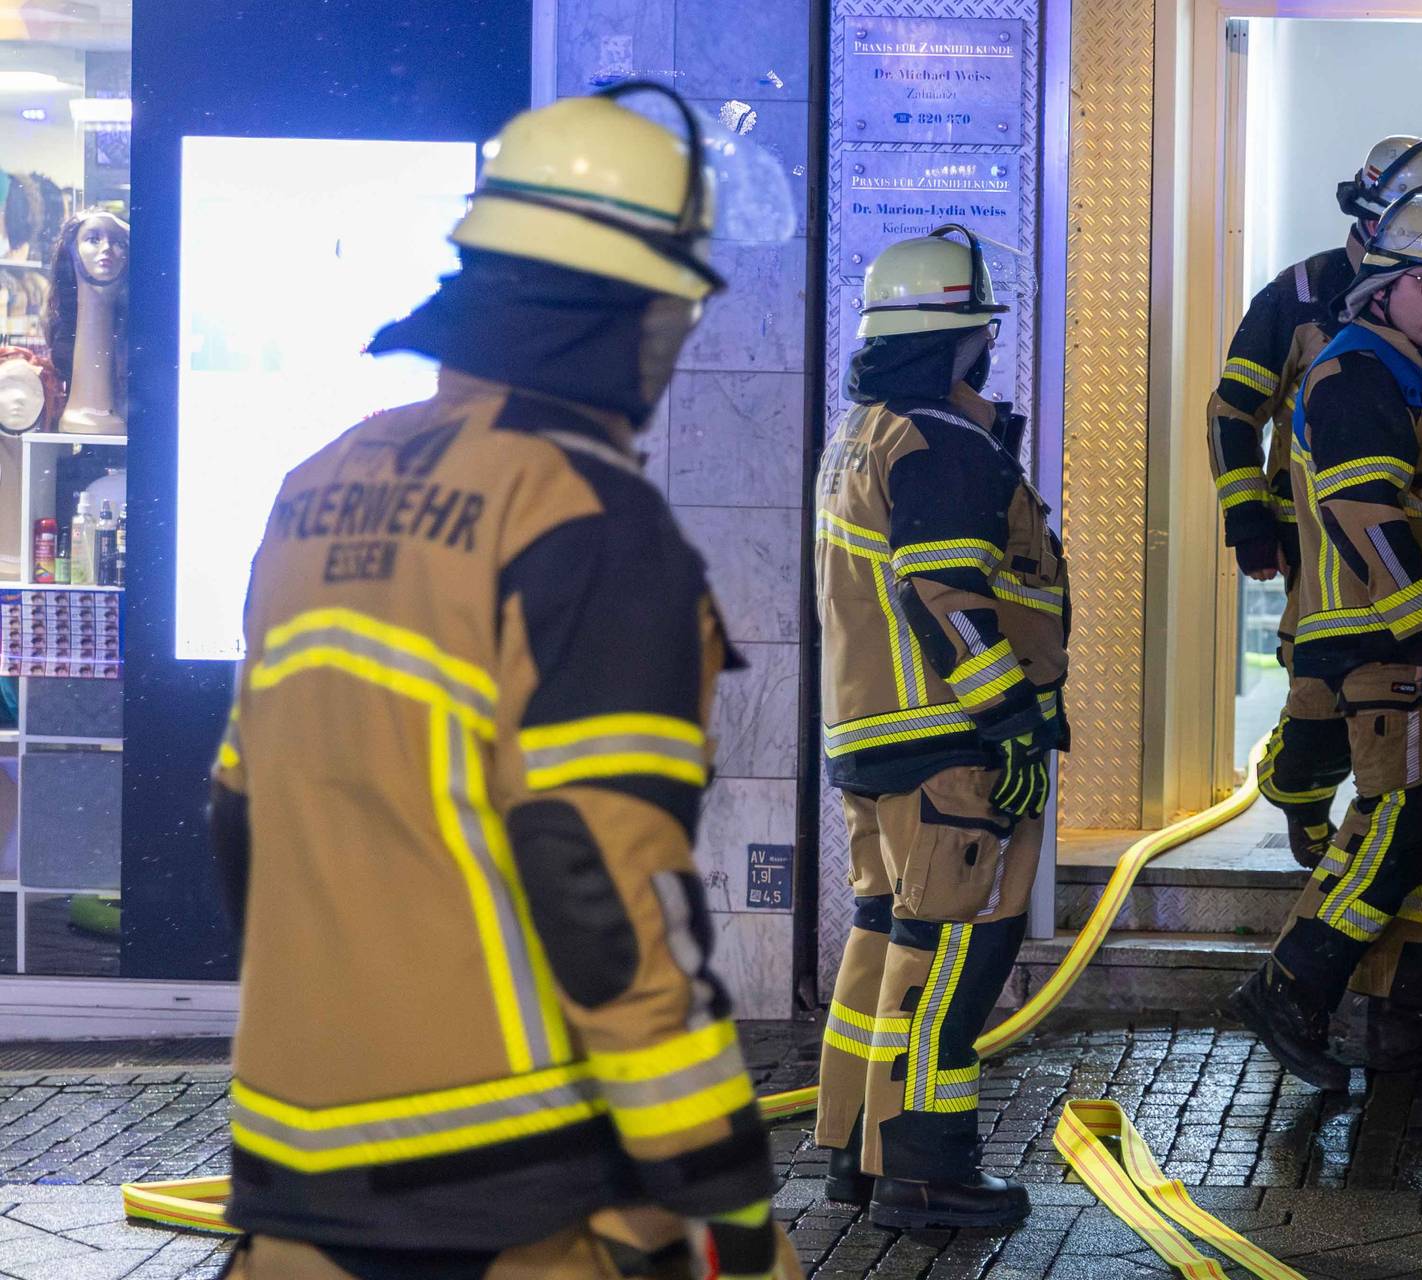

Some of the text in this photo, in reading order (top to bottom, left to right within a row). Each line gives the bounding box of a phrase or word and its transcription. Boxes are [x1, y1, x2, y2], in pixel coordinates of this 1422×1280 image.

[854, 41, 893, 52] PRAXIS
[874, 68, 991, 81] Dr. Michael Weiss
[918, 113, 942, 124] 820
[852, 175, 889, 187] PRAXIS
[853, 203, 1006, 218] Dr. Marion-Lydia Weiss
[750, 851, 766, 864] AV
[763, 890, 782, 905] 4,5
